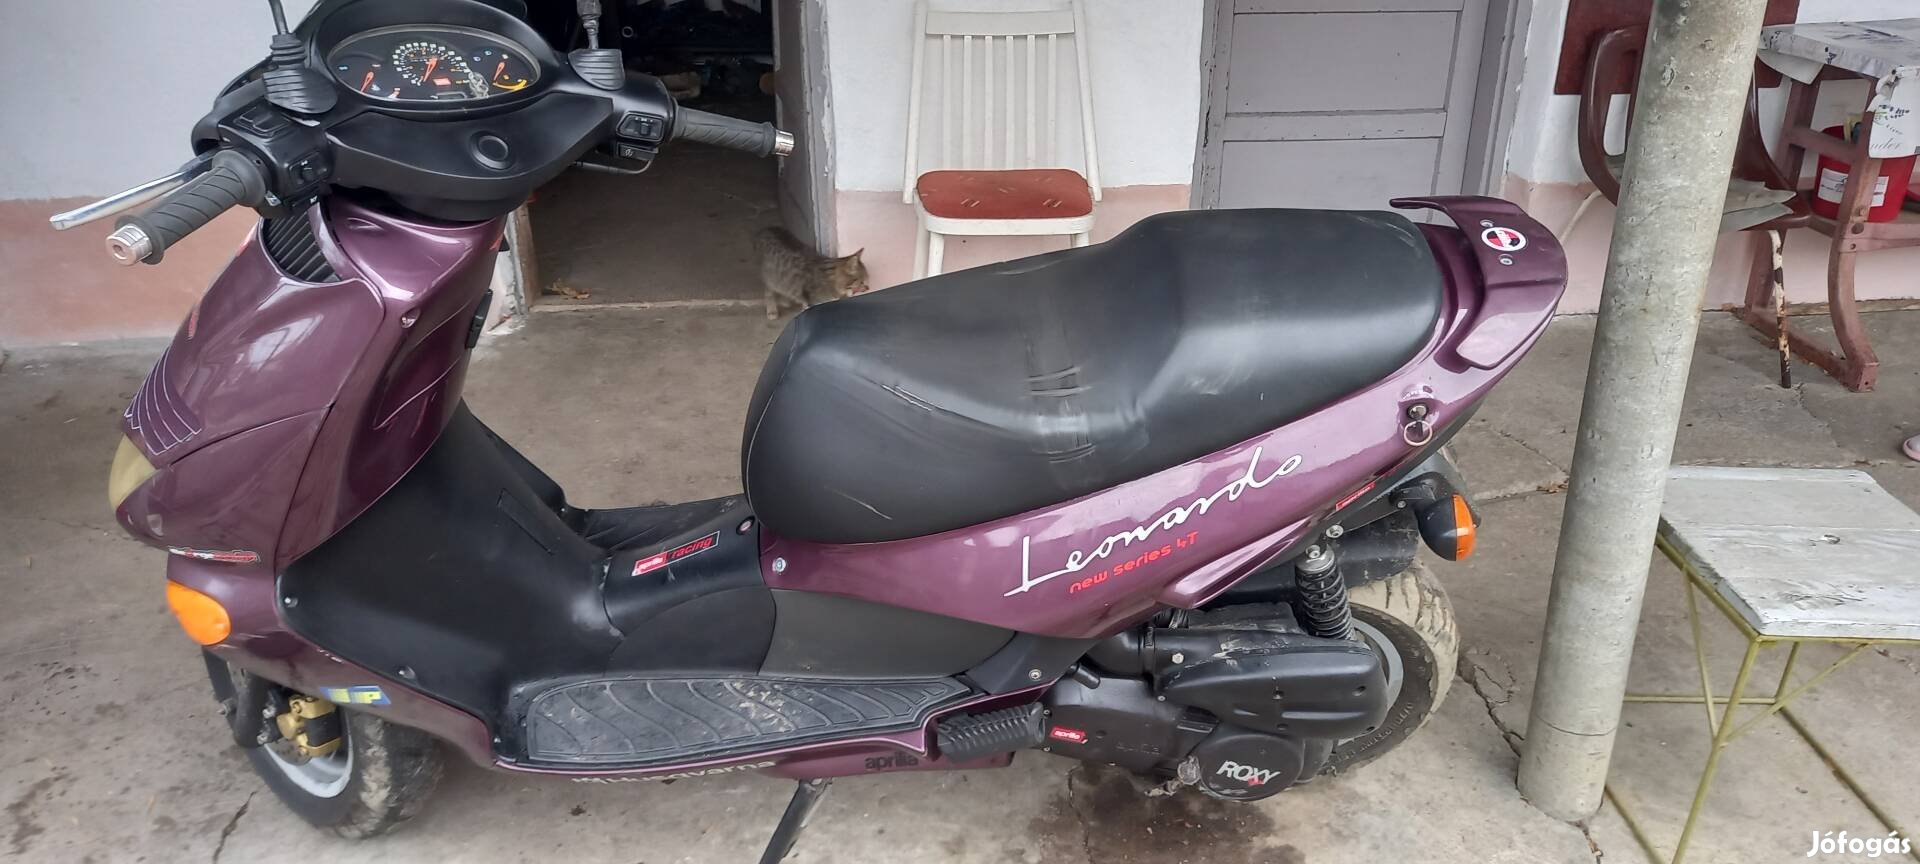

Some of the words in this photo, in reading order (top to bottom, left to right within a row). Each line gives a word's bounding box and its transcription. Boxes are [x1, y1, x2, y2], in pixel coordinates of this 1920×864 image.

[1004, 446, 1302, 598] Leonardo
[671, 537, 714, 559] racing
[1068, 570, 1109, 594] new
[1112, 544, 1172, 577] series
[1176, 531, 1199, 549] 4T
[865, 749, 919, 770] aprilia
[1216, 760, 1281, 785] ROXY
